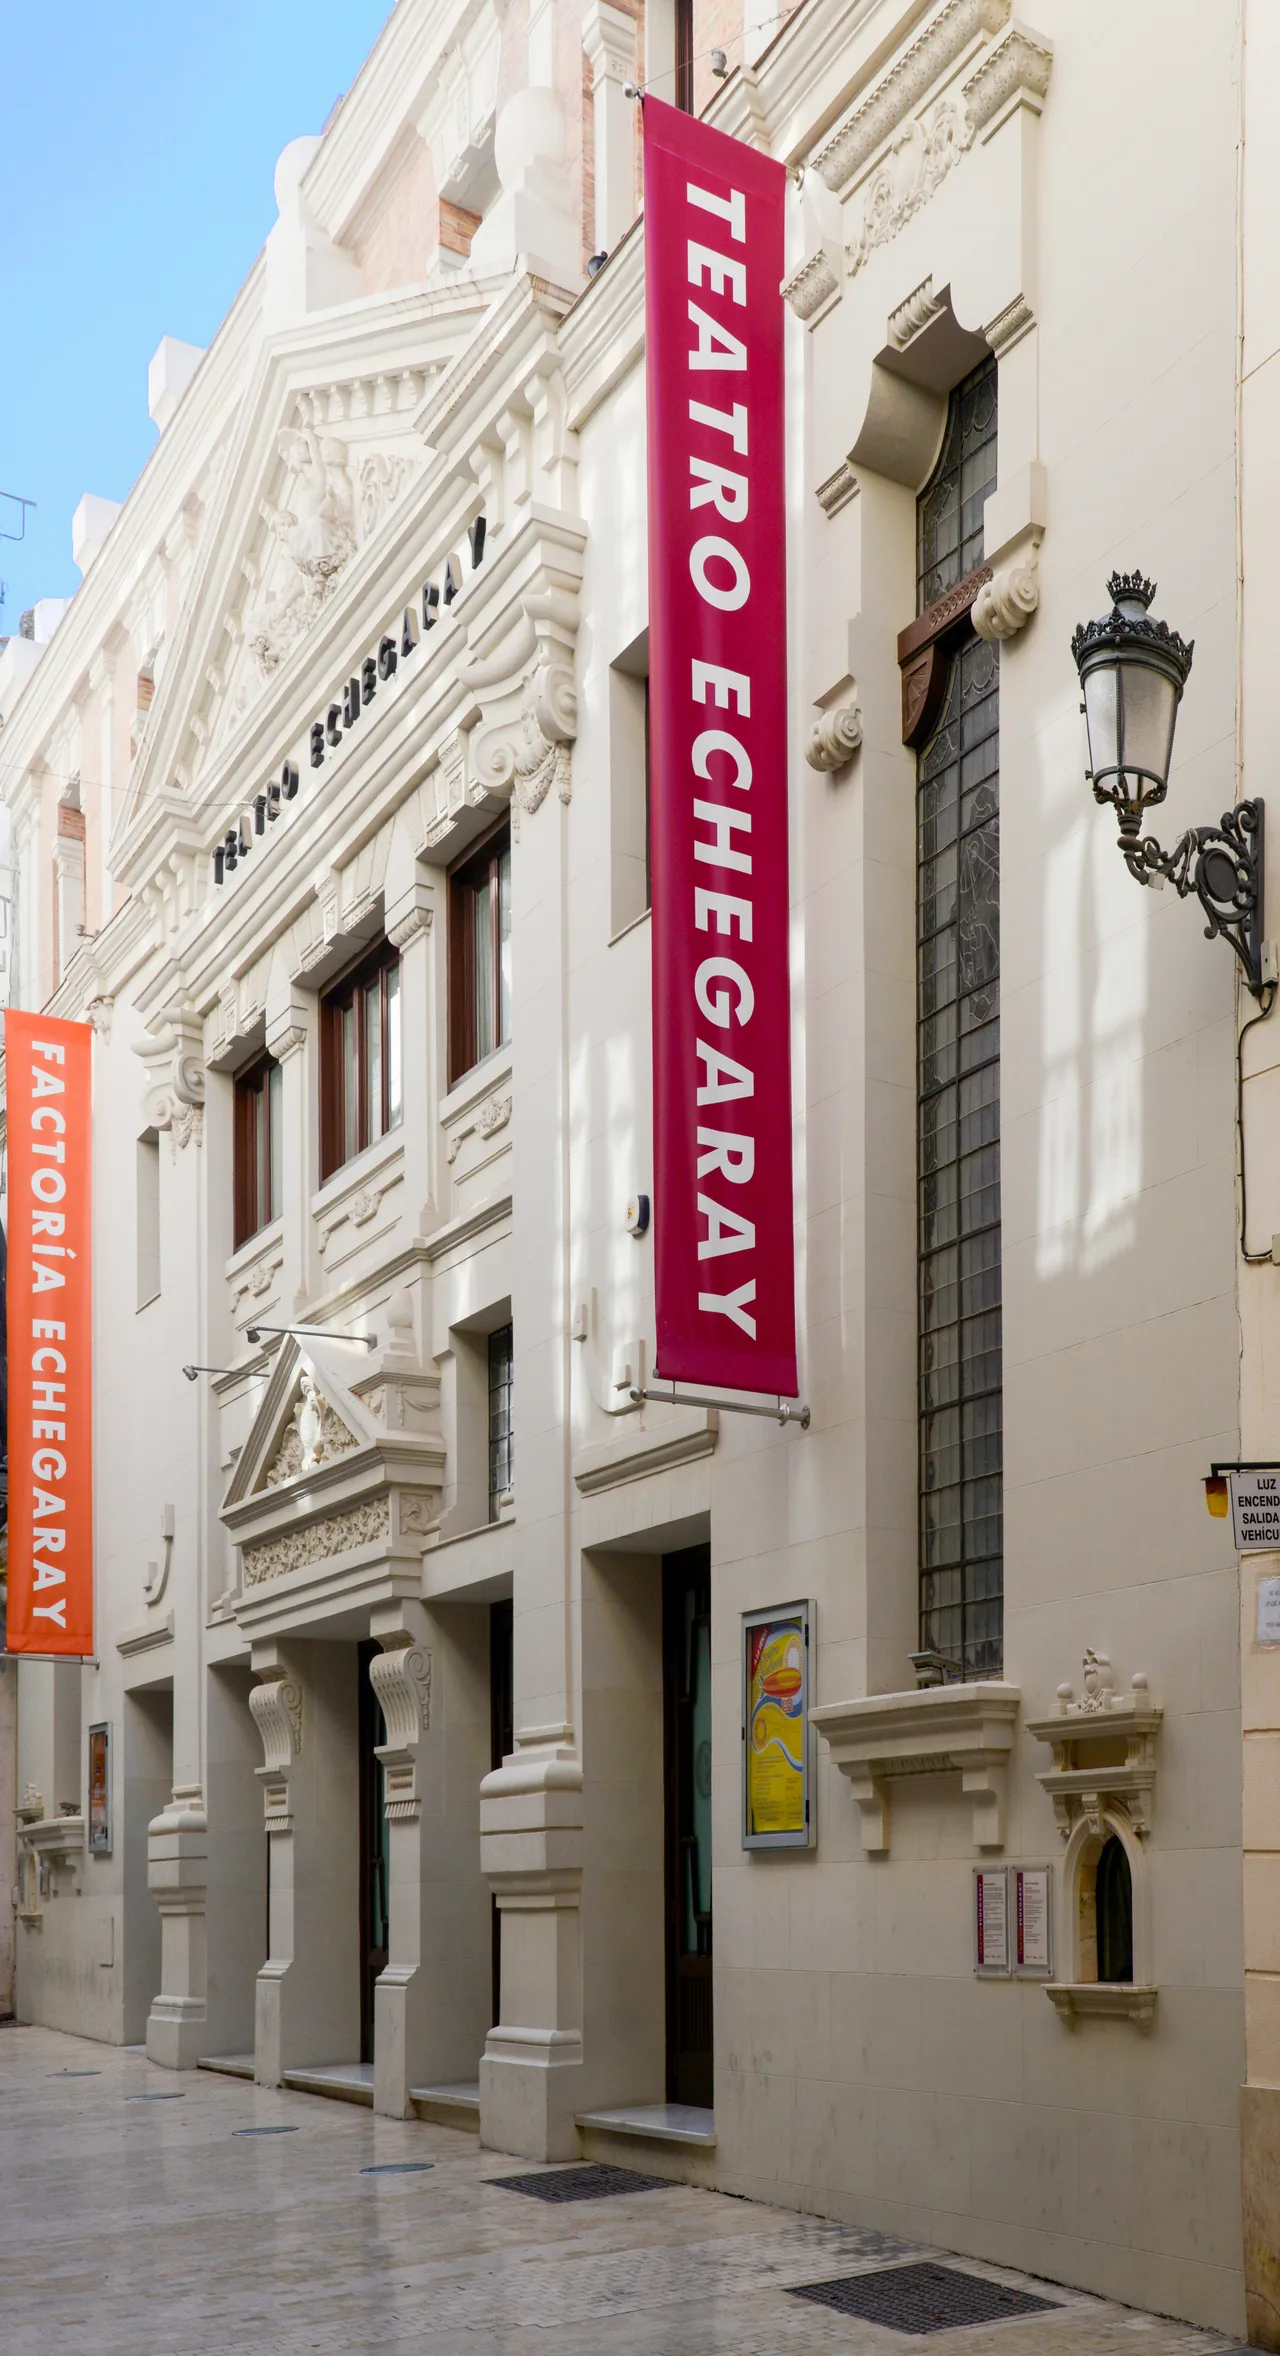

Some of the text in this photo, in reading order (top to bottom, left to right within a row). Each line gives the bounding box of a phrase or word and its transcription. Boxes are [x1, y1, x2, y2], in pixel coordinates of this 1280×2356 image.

[212, 516, 487, 885] TEATRO ECHEGARAY
[686, 182, 756, 1341] TEATRO ECHEGARAY
[30, 1040, 77, 1629] FACTORÍA ECHEGARAY
[1257, 1479, 1277, 1490] LUZ
[1238, 1495, 1280, 1507] ENCEND
[1242, 1512, 1280, 1524] SALIDA
[1241, 1526, 1279, 1541] VEHÍCU
